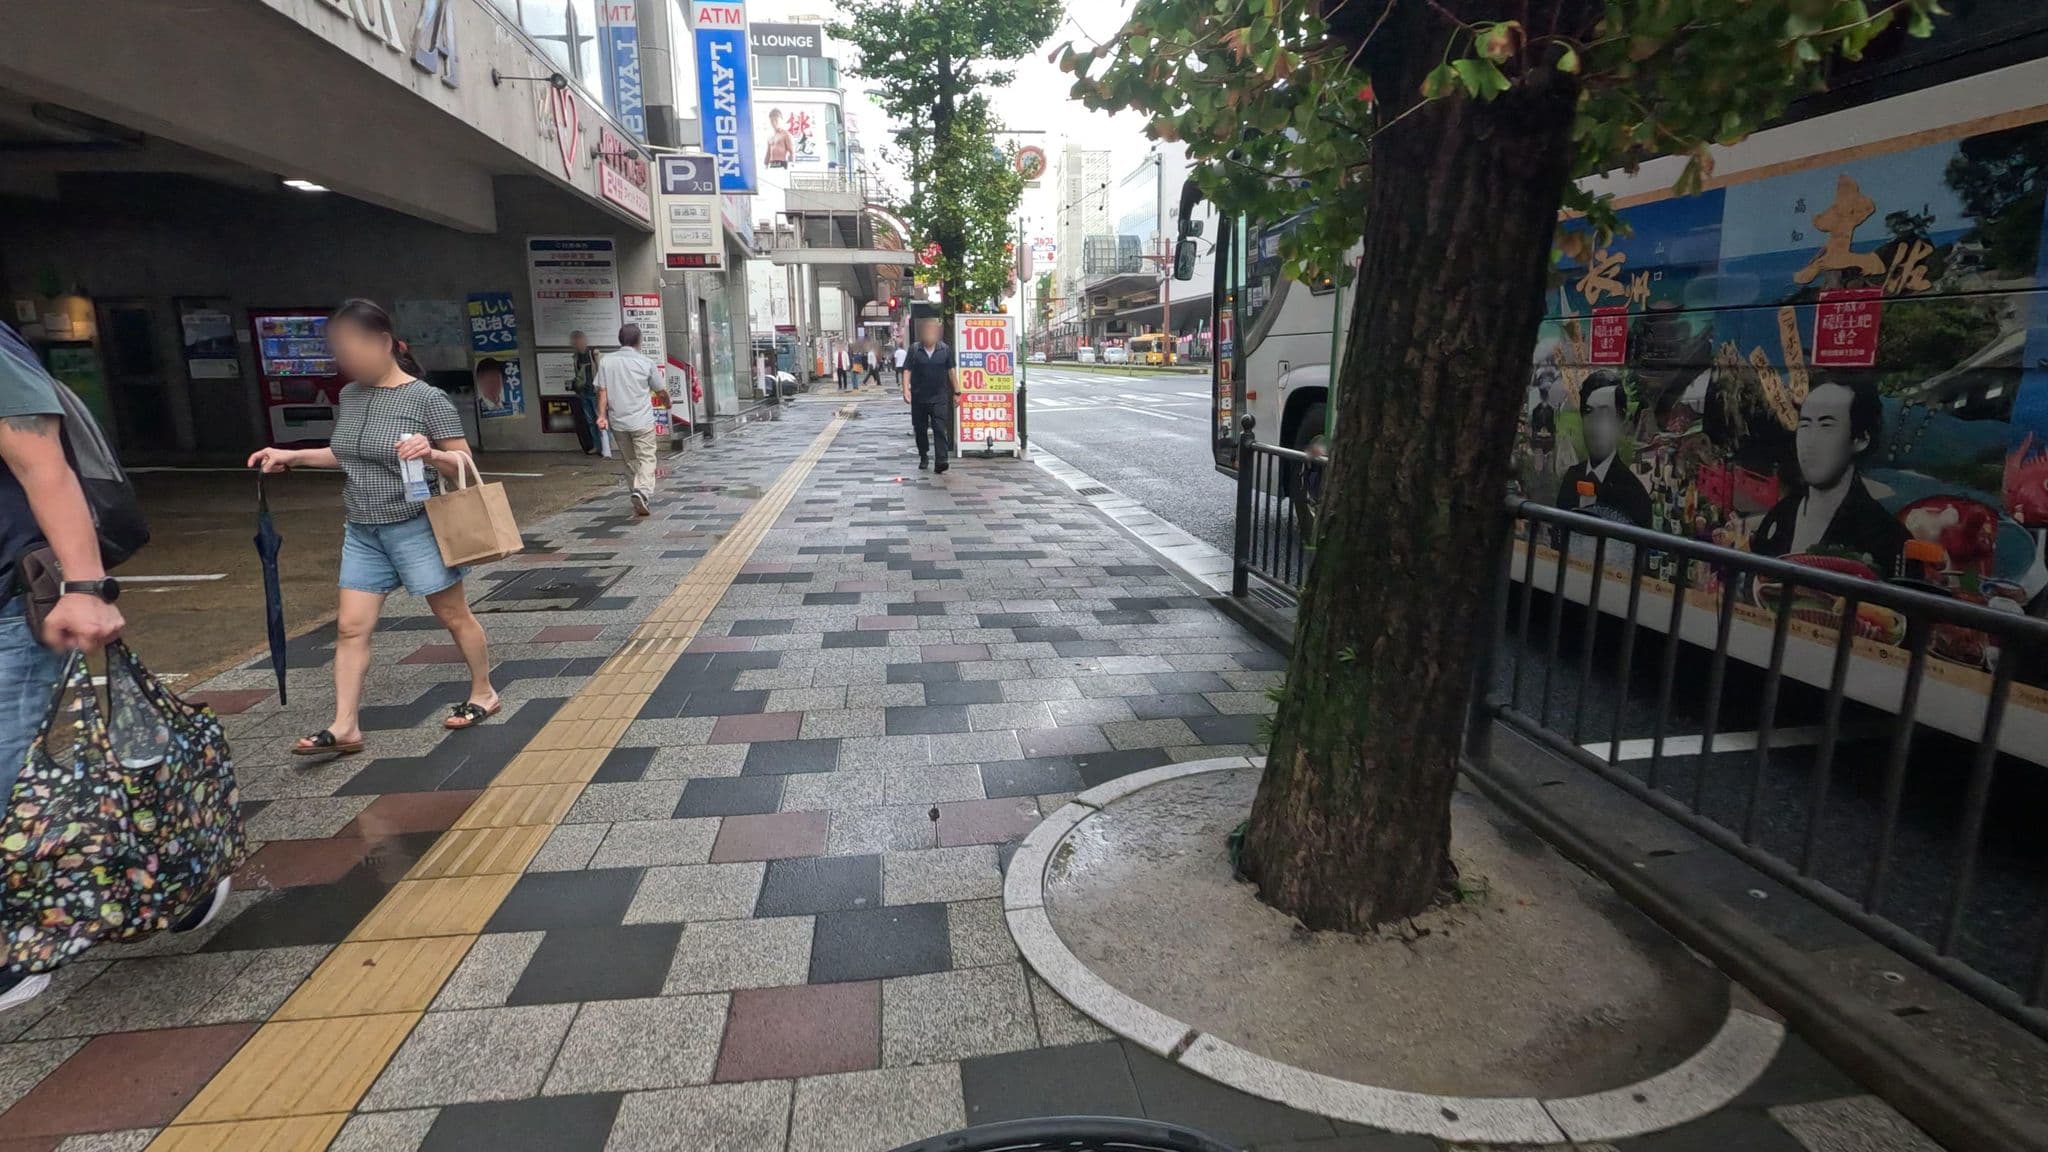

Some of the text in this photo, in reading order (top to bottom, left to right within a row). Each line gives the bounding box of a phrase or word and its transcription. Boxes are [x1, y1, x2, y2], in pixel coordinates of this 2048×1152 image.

[699, 8, 741, 24] ATM
[762, 35, 813, 48] LOUNGE
[710, 41, 741, 177] LAWSON
[692, 181, 713, 192] 入口
[1790, 197, 1807, 243] 高知
[1793, 174, 1935, 295] 土佐
[1653, 241, 1665, 281] 山口
[471, 313, 518, 332] 政治を
[1833, 329, 1859, 345] 連合
